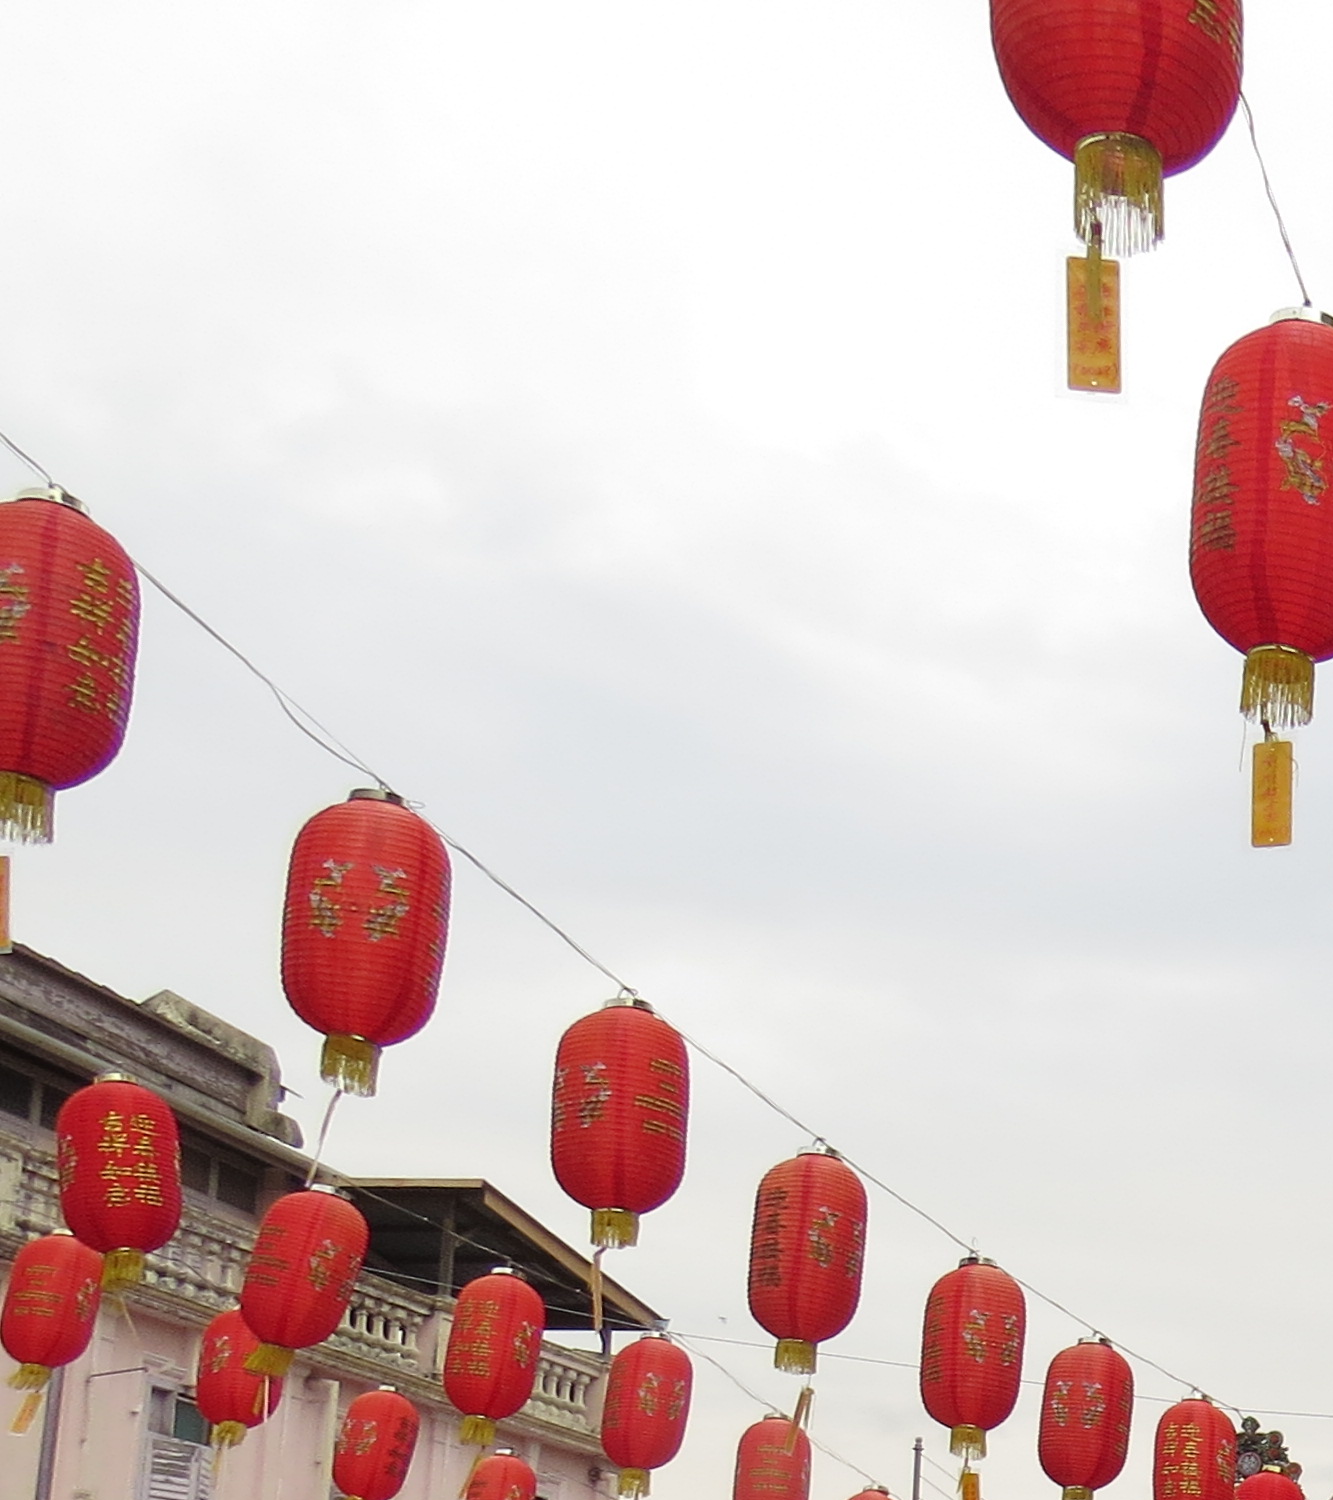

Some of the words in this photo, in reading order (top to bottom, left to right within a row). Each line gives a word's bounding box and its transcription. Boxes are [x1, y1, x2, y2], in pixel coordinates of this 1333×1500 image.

[98, 1110, 132, 1207] 吉祥如意
[130, 1113, 163, 1207] 迎春接福
